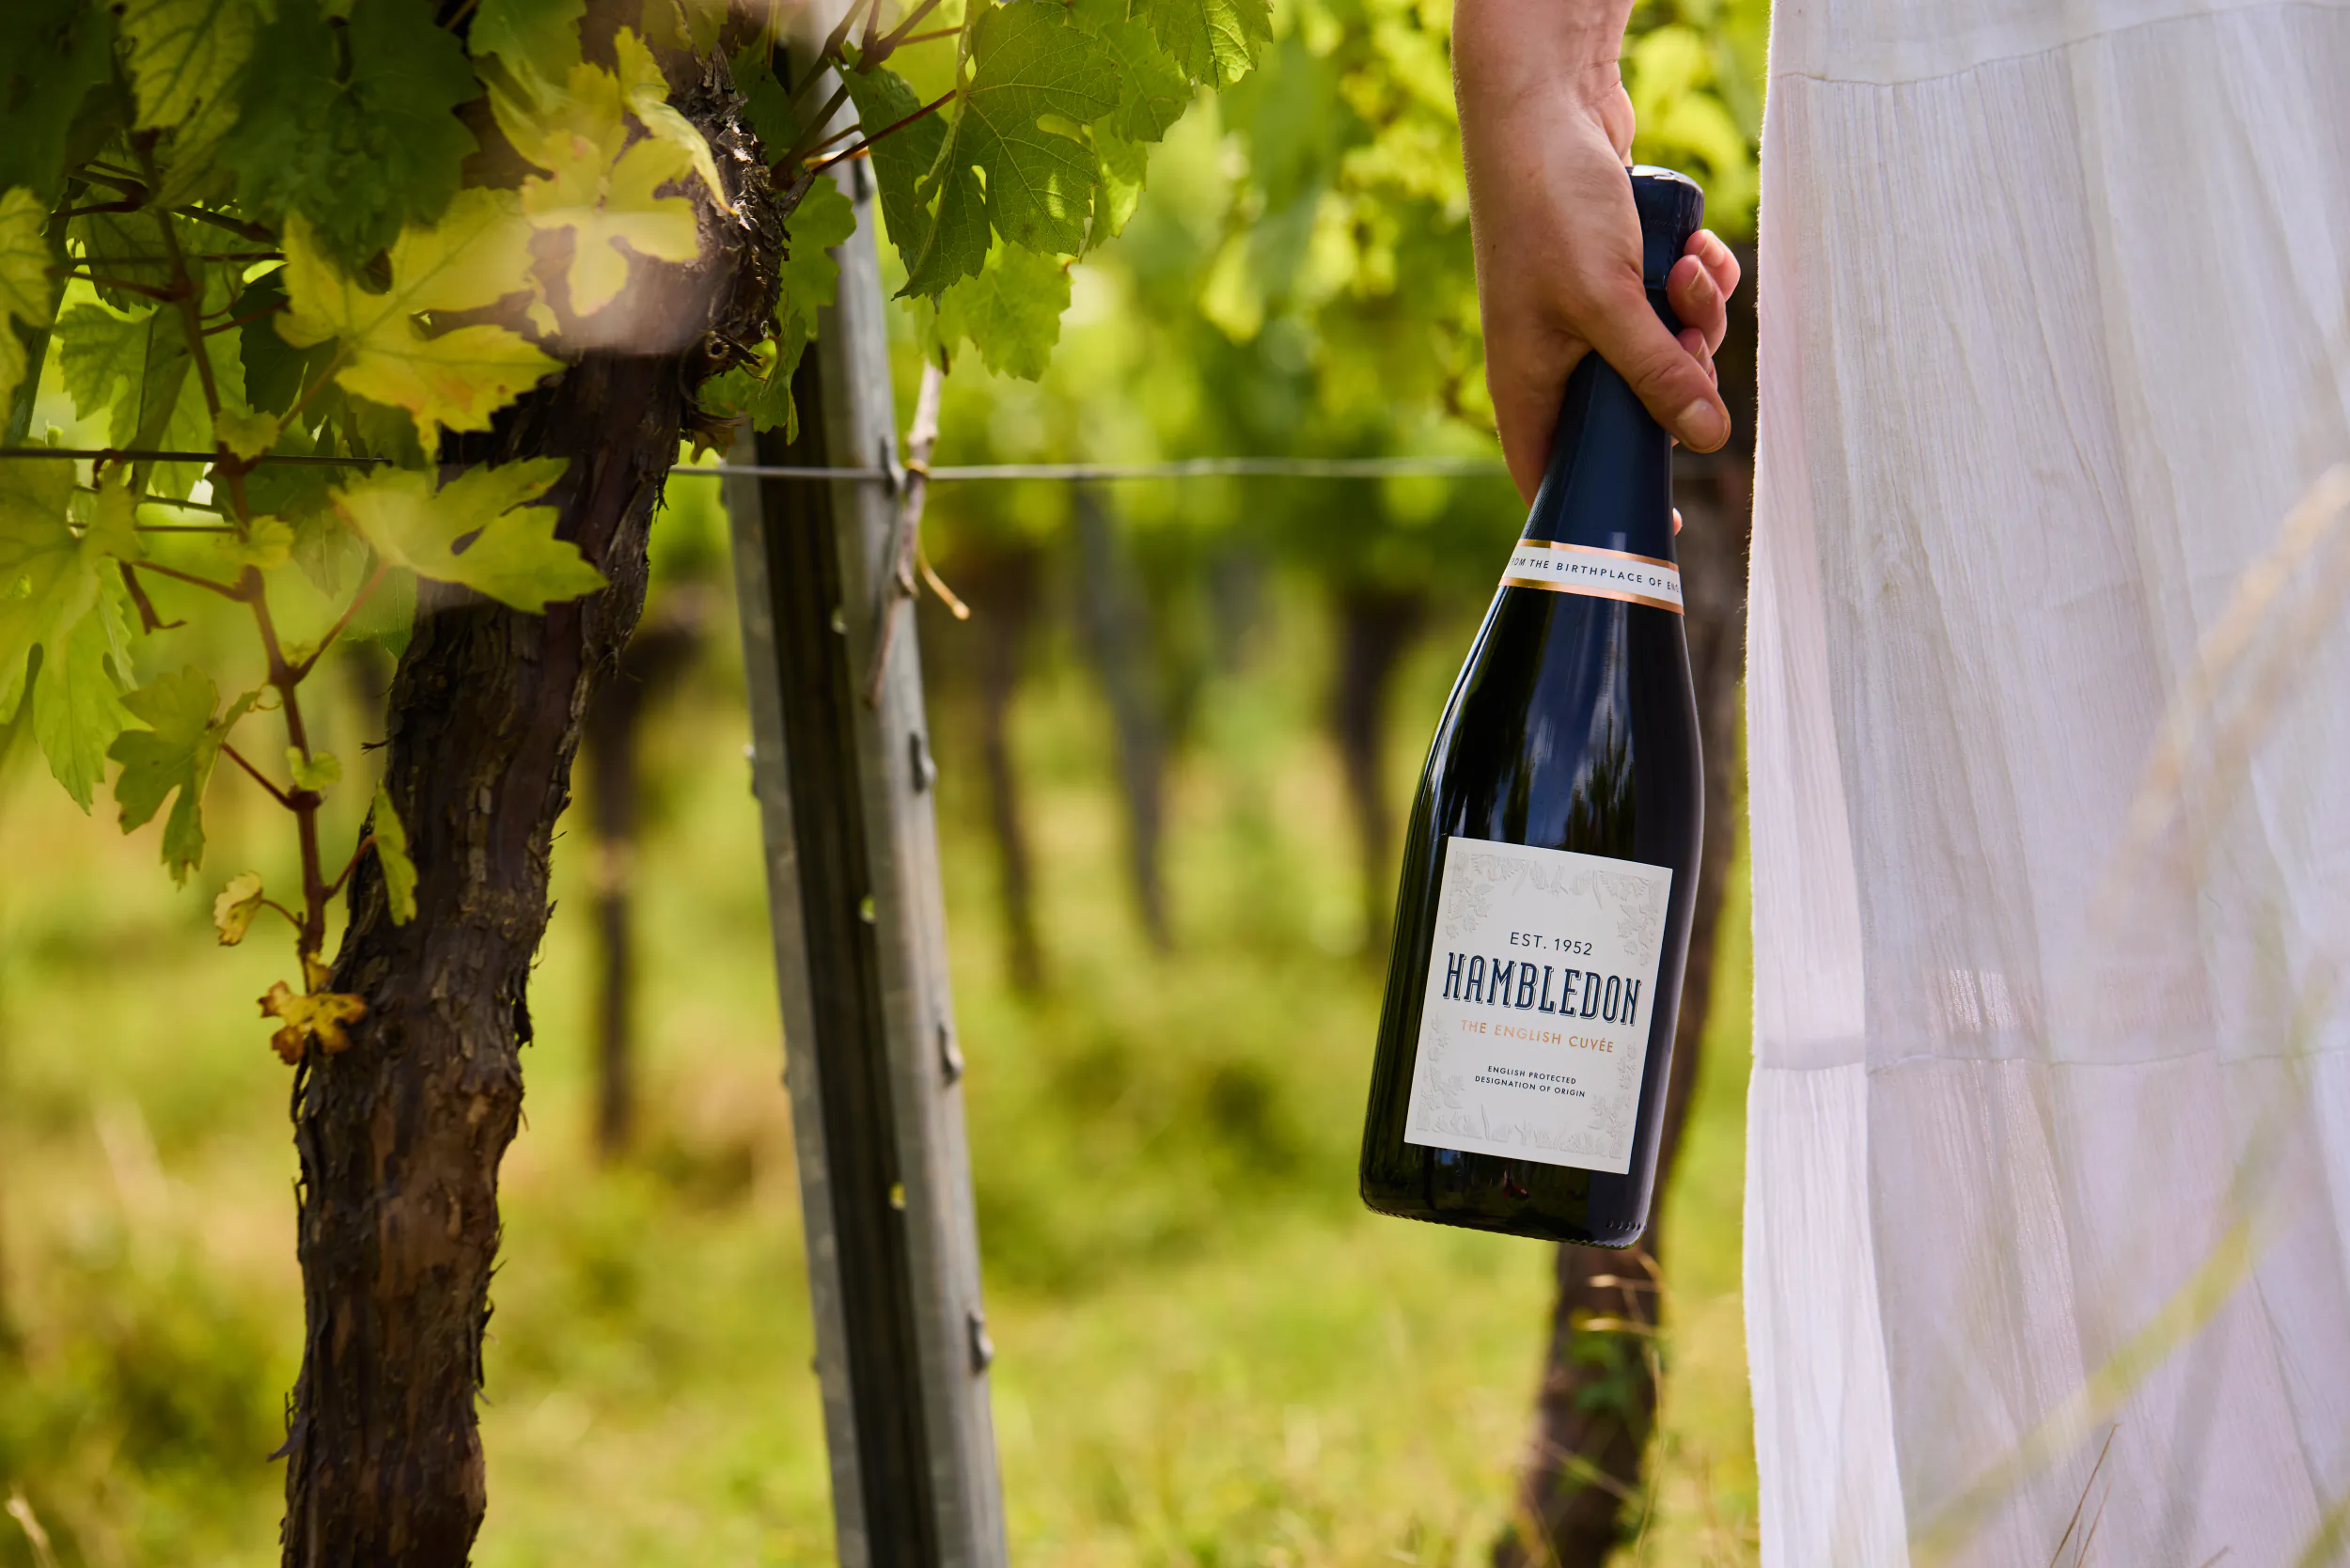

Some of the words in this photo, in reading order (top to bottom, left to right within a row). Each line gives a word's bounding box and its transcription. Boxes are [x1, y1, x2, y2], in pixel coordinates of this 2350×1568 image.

[1529, 558, 1549, 569] THE
[1556, 562, 1643, 583] BIRTHPLACE
[1649, 577, 1662, 588] OF
[1510, 932, 1547, 950] EST.
[1554, 938, 1593, 956] 1952
[1442, 951, 1643, 1027] HAMBLEDON
[1461, 1019, 1487, 1034] THE
[1495, 1024, 1561, 1045] ENGLISH
[1569, 1037, 1614, 1053] CUVÉE
[1474, 1075, 1536, 1092] DESIGNATION
[1539, 1085, 1551, 1093] OF
[1554, 1088, 1586, 1098] ORIGIN
[1487, 1065, 1526, 1078] ENGLISH
[1528, 1072, 1577, 1085] PROTECTED
